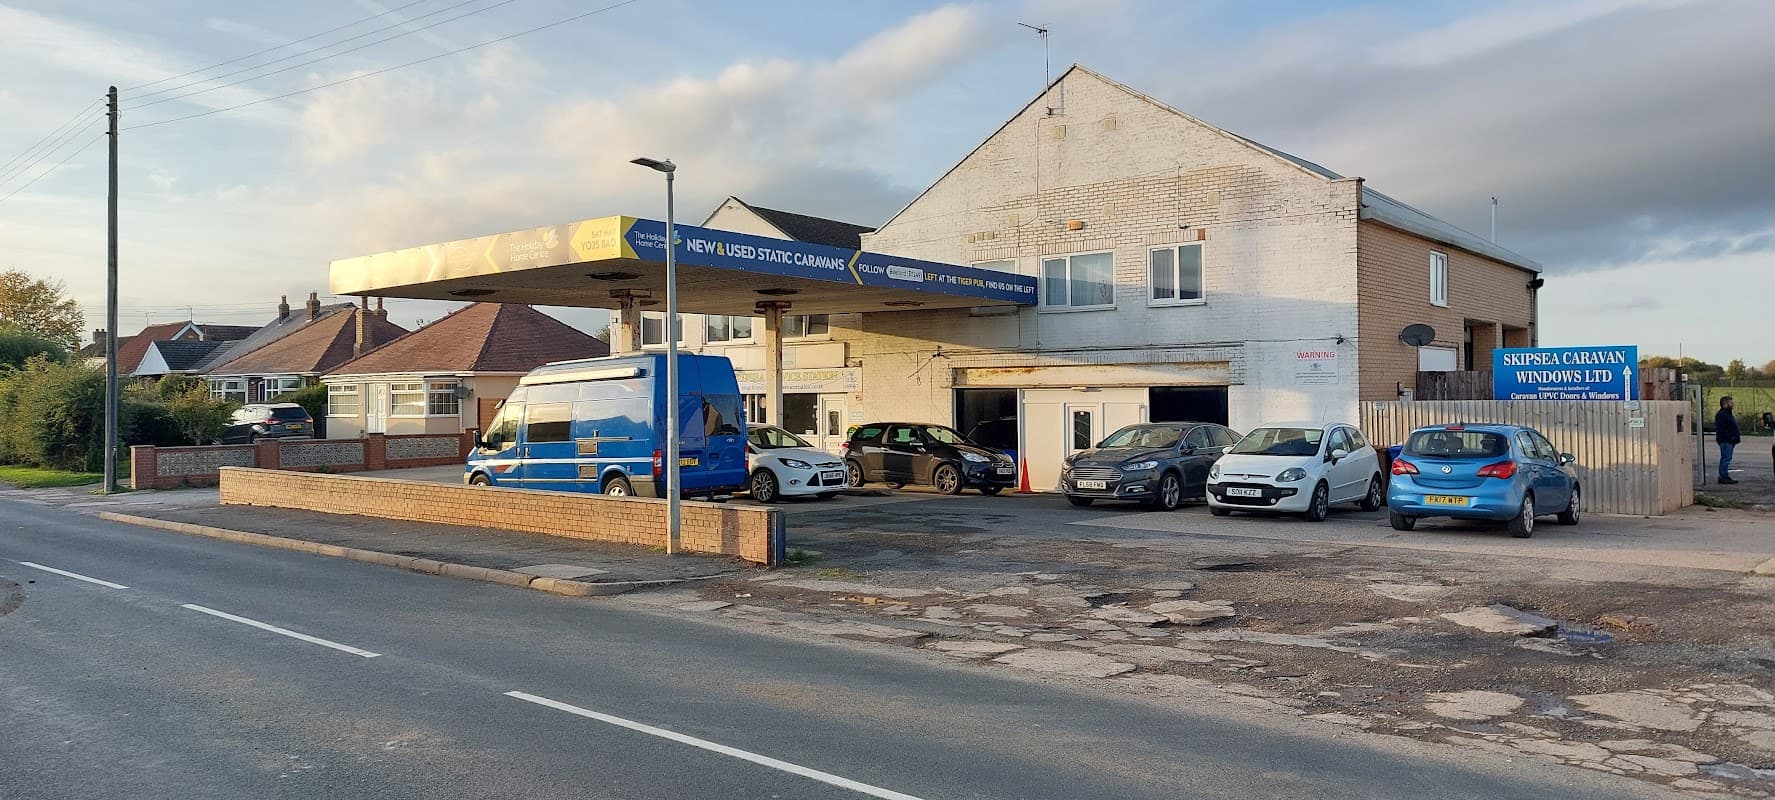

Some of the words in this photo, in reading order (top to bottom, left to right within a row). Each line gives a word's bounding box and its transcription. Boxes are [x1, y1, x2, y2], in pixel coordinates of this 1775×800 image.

[634, 231, 646, 240] The
[581, 240, 600, 251] YO25
[636, 239, 652, 248] Home
[653, 241, 667, 250] Cen
[686, 238, 717, 254] NEW
[726, 243, 756, 260] USED
[758, 247, 792, 264] STATIC
[794, 253, 845, 271] CARAVANS
[858, 263, 885, 276] FOLLOW
[924, 272, 937, 282] LEFT
[938, 274, 946, 282] AT
[946, 275, 957, 284] THE
[957, 276, 972, 286] TIGER
[985, 280, 998, 290] FIND
[998, 282, 1005, 290] US
[1006, 283, 1014, 292] ON
[1014, 284, 1023, 293] THE
[1024, 285, 1034, 294] LEFT
[1503, 352, 1560, 366] SKIPSEA
[1562, 350, 1625, 365] CARAVAN
[1516, 370, 1582, 384] WINDOWS
[1584, 369, 1612, 383] LTD
[1510, 392, 1538, 400] Caravan
[1538, 392, 1559, 400] UPVC
[1560, 392, 1580, 400] Doors
[1588, 391, 1620, 400] Windows
